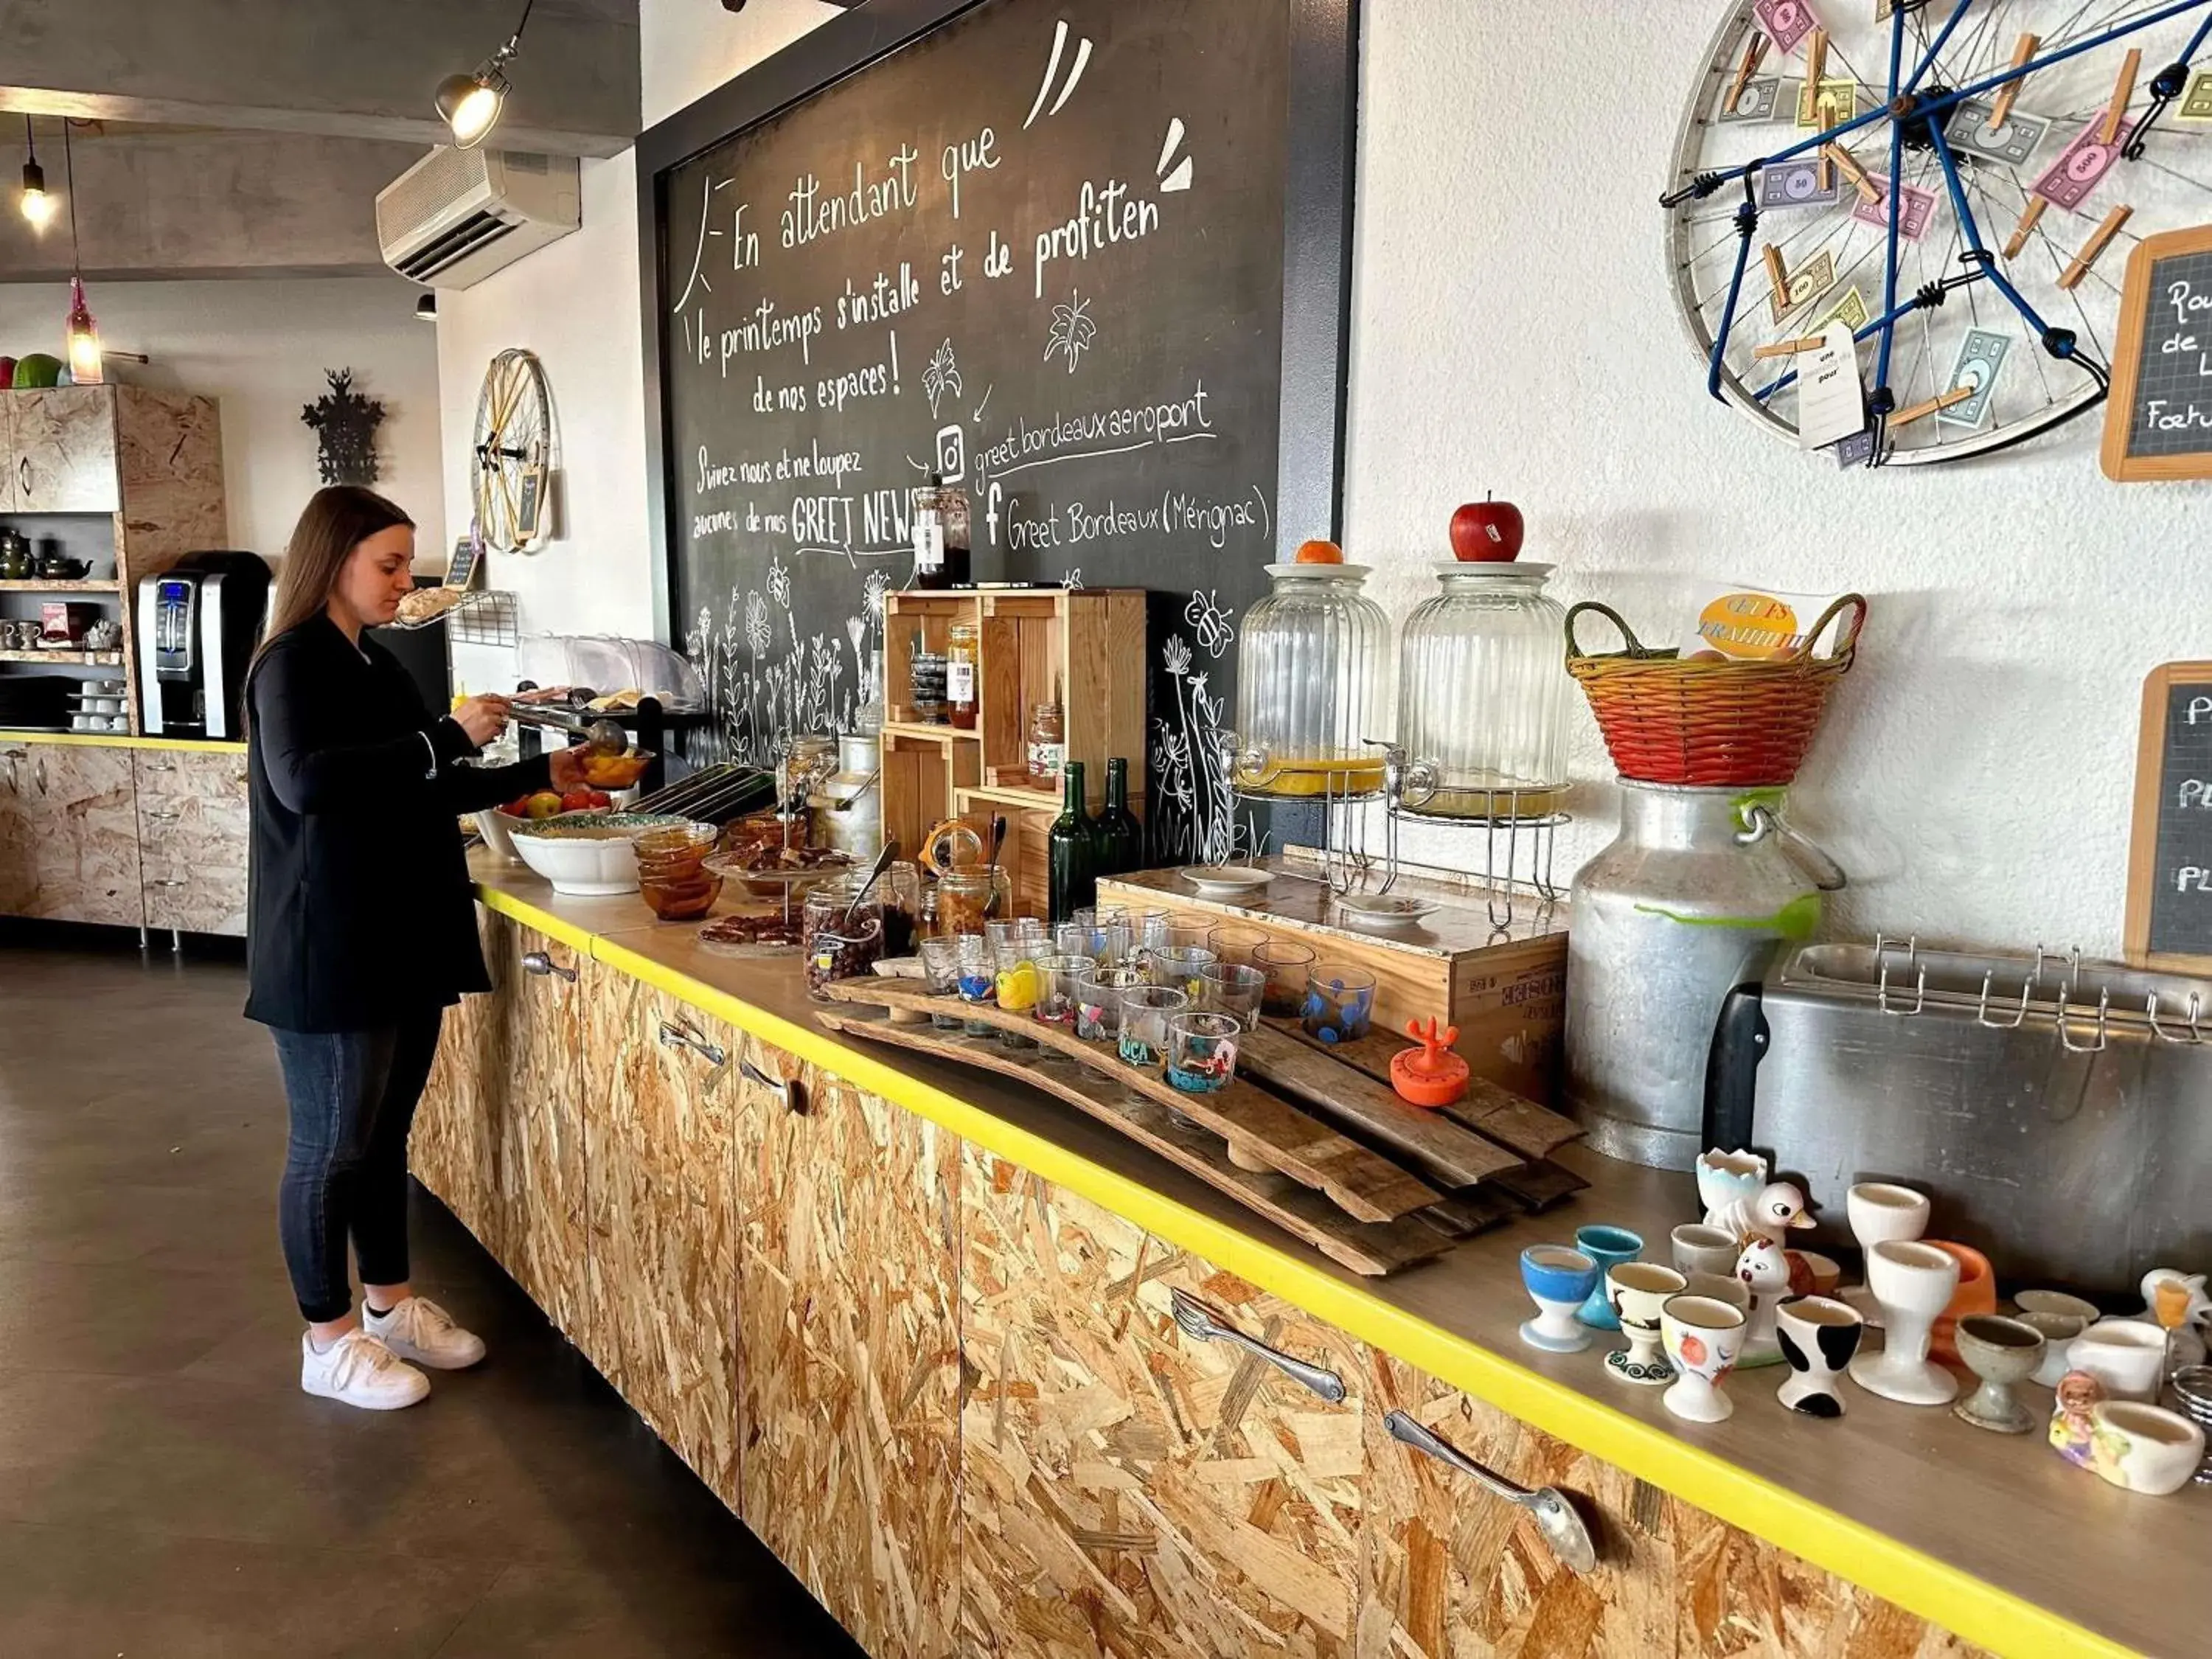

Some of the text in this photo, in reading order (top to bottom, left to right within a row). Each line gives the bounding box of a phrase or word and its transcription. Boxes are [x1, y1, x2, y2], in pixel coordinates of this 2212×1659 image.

[733, 127, 1001, 271] En attendant que
[1795, 179, 1807, 189] 50
[697, 307, 712, 364] le
[721, 297, 822, 378] printemps
[838, 262, 919, 332] s'installe
[940, 244, 964, 296] et
[984, 231, 1013, 279] de
[1794, 281, 1809, 296] 100
[2162, 333, 2198, 353] de
[753, 375, 775, 414] de
[778, 388, 806, 413] nos
[740, 460, 771, 484] nous
[776, 448, 791, 479] et
[793, 458, 810, 478] ne
[813, 438, 862, 490] loupez
[745, 502, 761, 532] de
[765, 515, 787, 533] nos
[792, 496, 854, 544] GREET
[1007, 499, 1061, 550] Greet
[1067, 501, 1159, 544] Bordeaux
